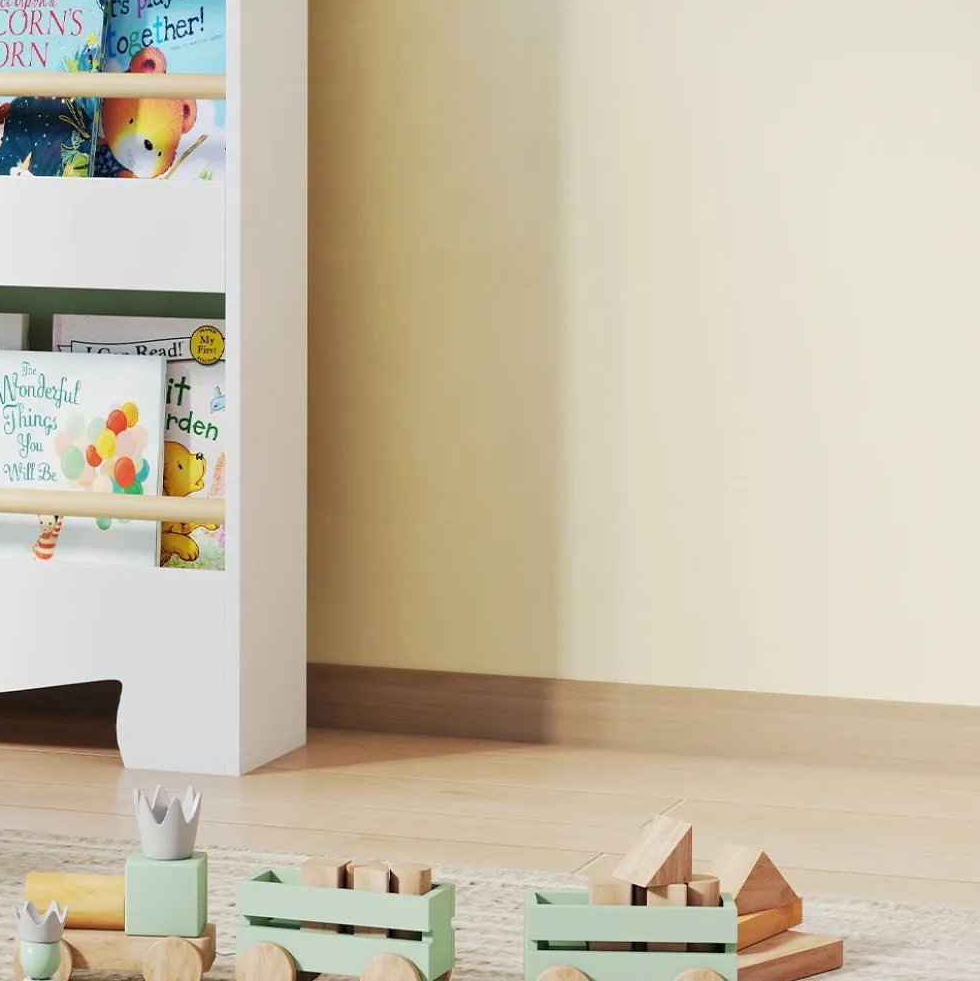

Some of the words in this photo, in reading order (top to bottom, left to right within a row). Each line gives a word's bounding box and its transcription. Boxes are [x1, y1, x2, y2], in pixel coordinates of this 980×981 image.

[107, 6, 204, 58] together!
[197, 345, 217, 355] First
[200, 335, 216, 346] My
[21, 361, 37, 377] The
[2, 404, 58, 435] Things
[17, 433, 45, 459] You
[3, 463, 37, 482] Will
[37, 463, 58, 482] Be
